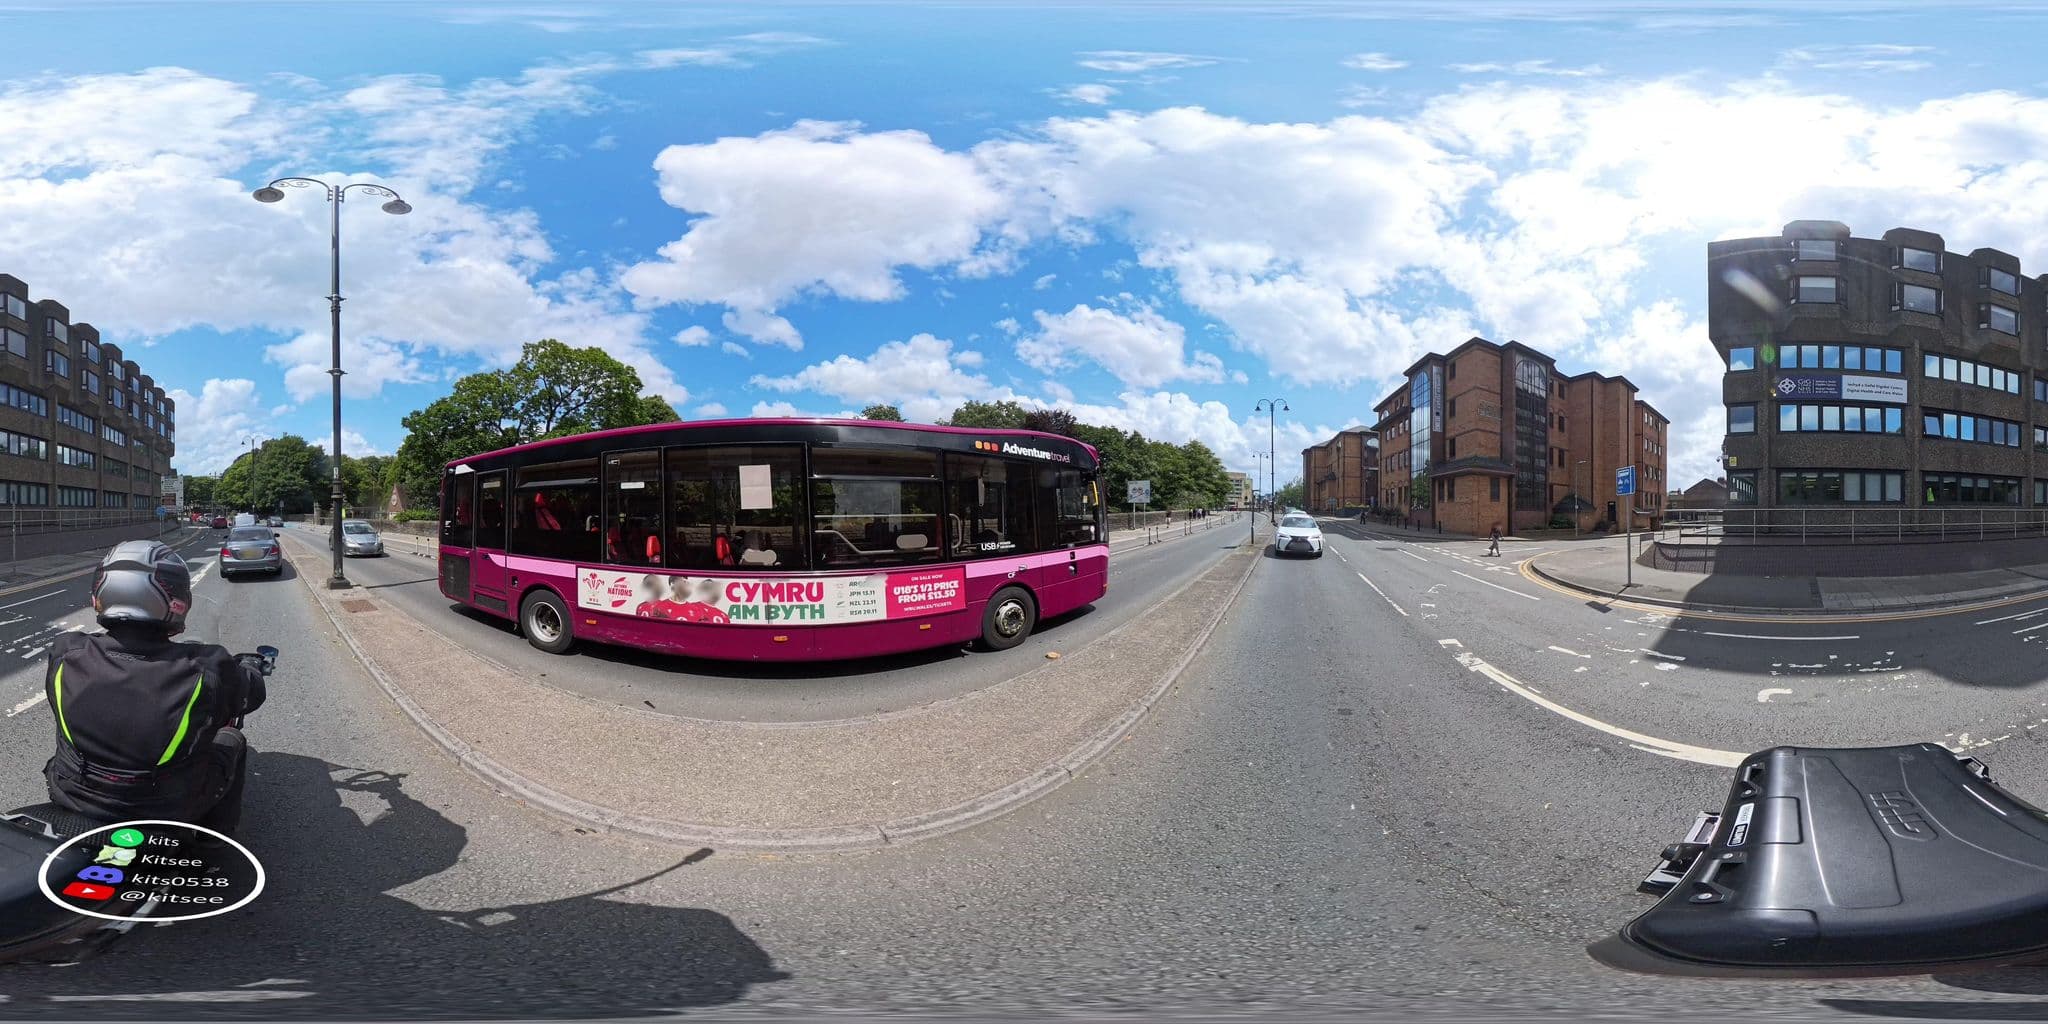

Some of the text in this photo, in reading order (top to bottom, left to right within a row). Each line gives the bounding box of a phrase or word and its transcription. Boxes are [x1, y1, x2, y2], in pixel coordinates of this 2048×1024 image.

[981, 542, 996, 551] USB
[933, 580, 959, 591] PRICE
[607, 587, 633, 597] NATIONS
[725, 581, 824, 603] CYMRU
[898, 592, 926, 604] FROM
[728, 604, 825, 620] AM BYTH
